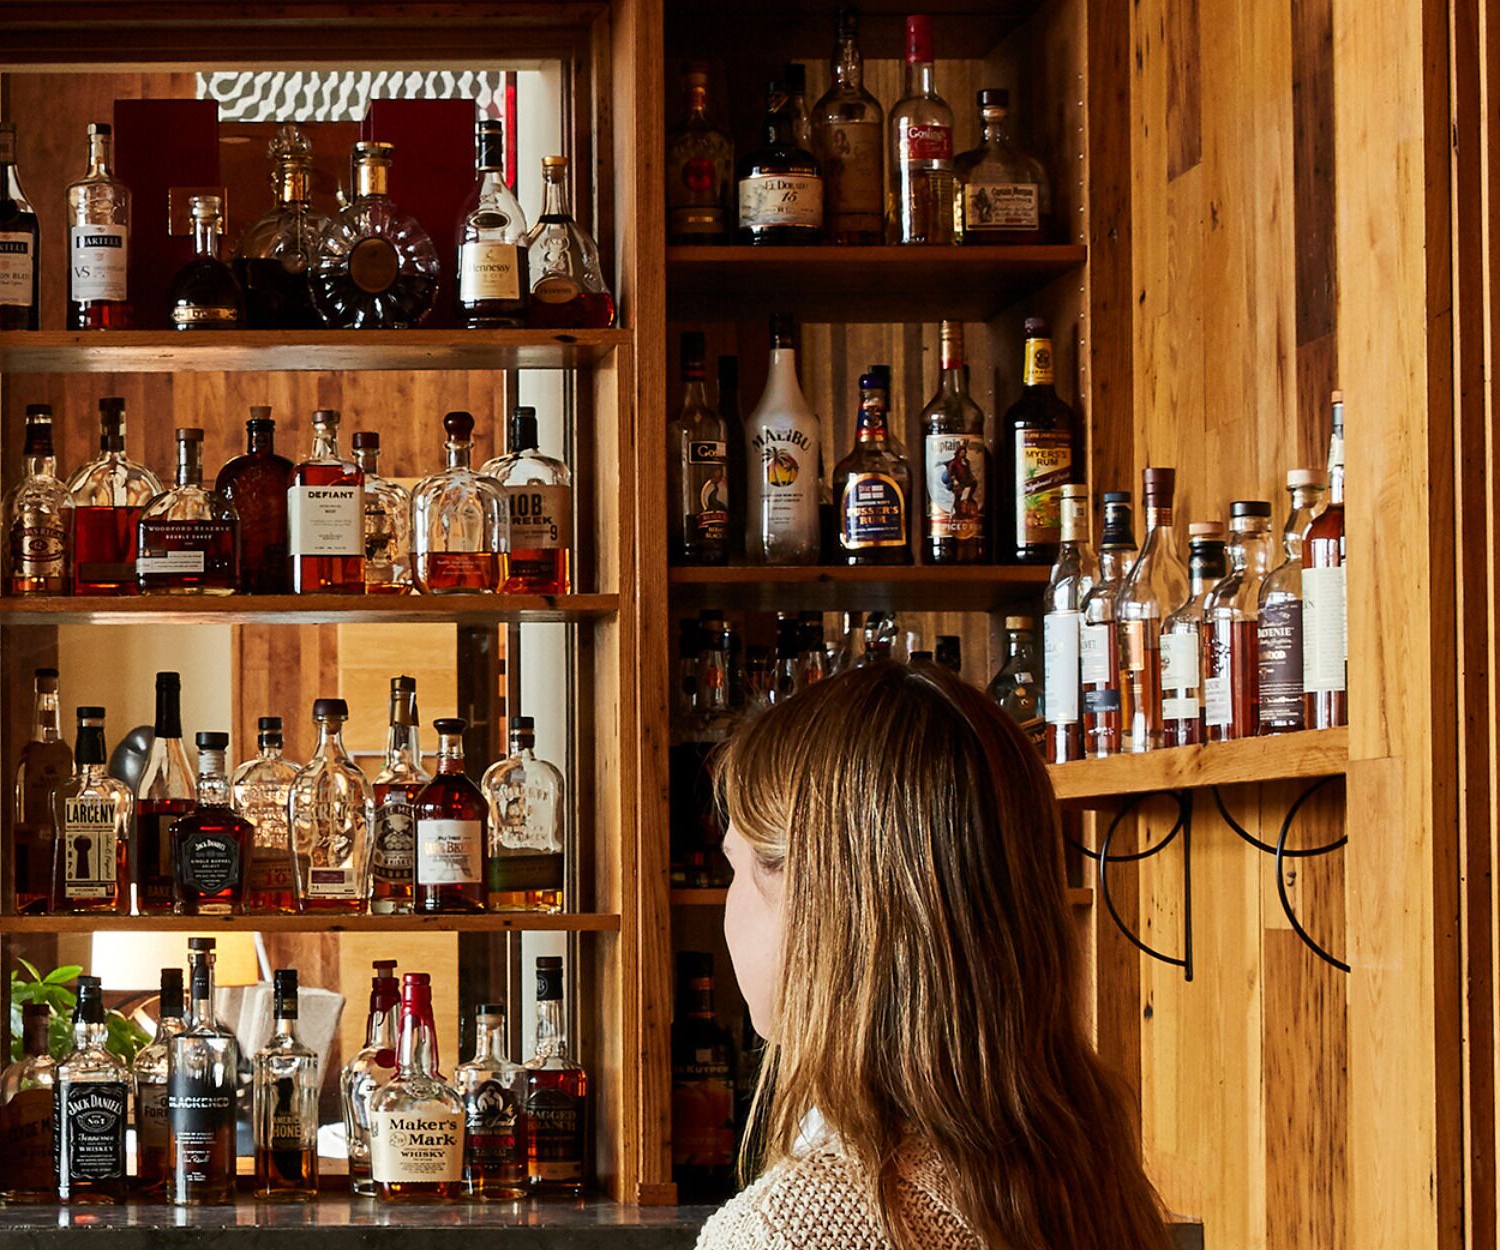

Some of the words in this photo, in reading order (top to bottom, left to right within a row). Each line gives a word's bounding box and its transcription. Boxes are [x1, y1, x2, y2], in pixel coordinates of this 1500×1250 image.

[82, 236, 120, 247] ARTELL
[74, 266, 90, 279] VS
[1036, 458, 1059, 467] RUM
[308, 491, 354, 499] DEFIANT
[511, 516, 553, 525] REEK
[148, 524, 192, 532] WOODFORD
[196, 524, 230, 532] RESERVE
[550, 524, 558, 541] 9
[66, 803, 116, 823] LARCENY
[68, 1098, 90, 1116] JACK
[168, 1096, 230, 1109] BLACKENED
[389, 1118, 458, 1131] Maker's
[272, 1124, 301, 1139] HONE
[408, 1133, 456, 1146] Mark
